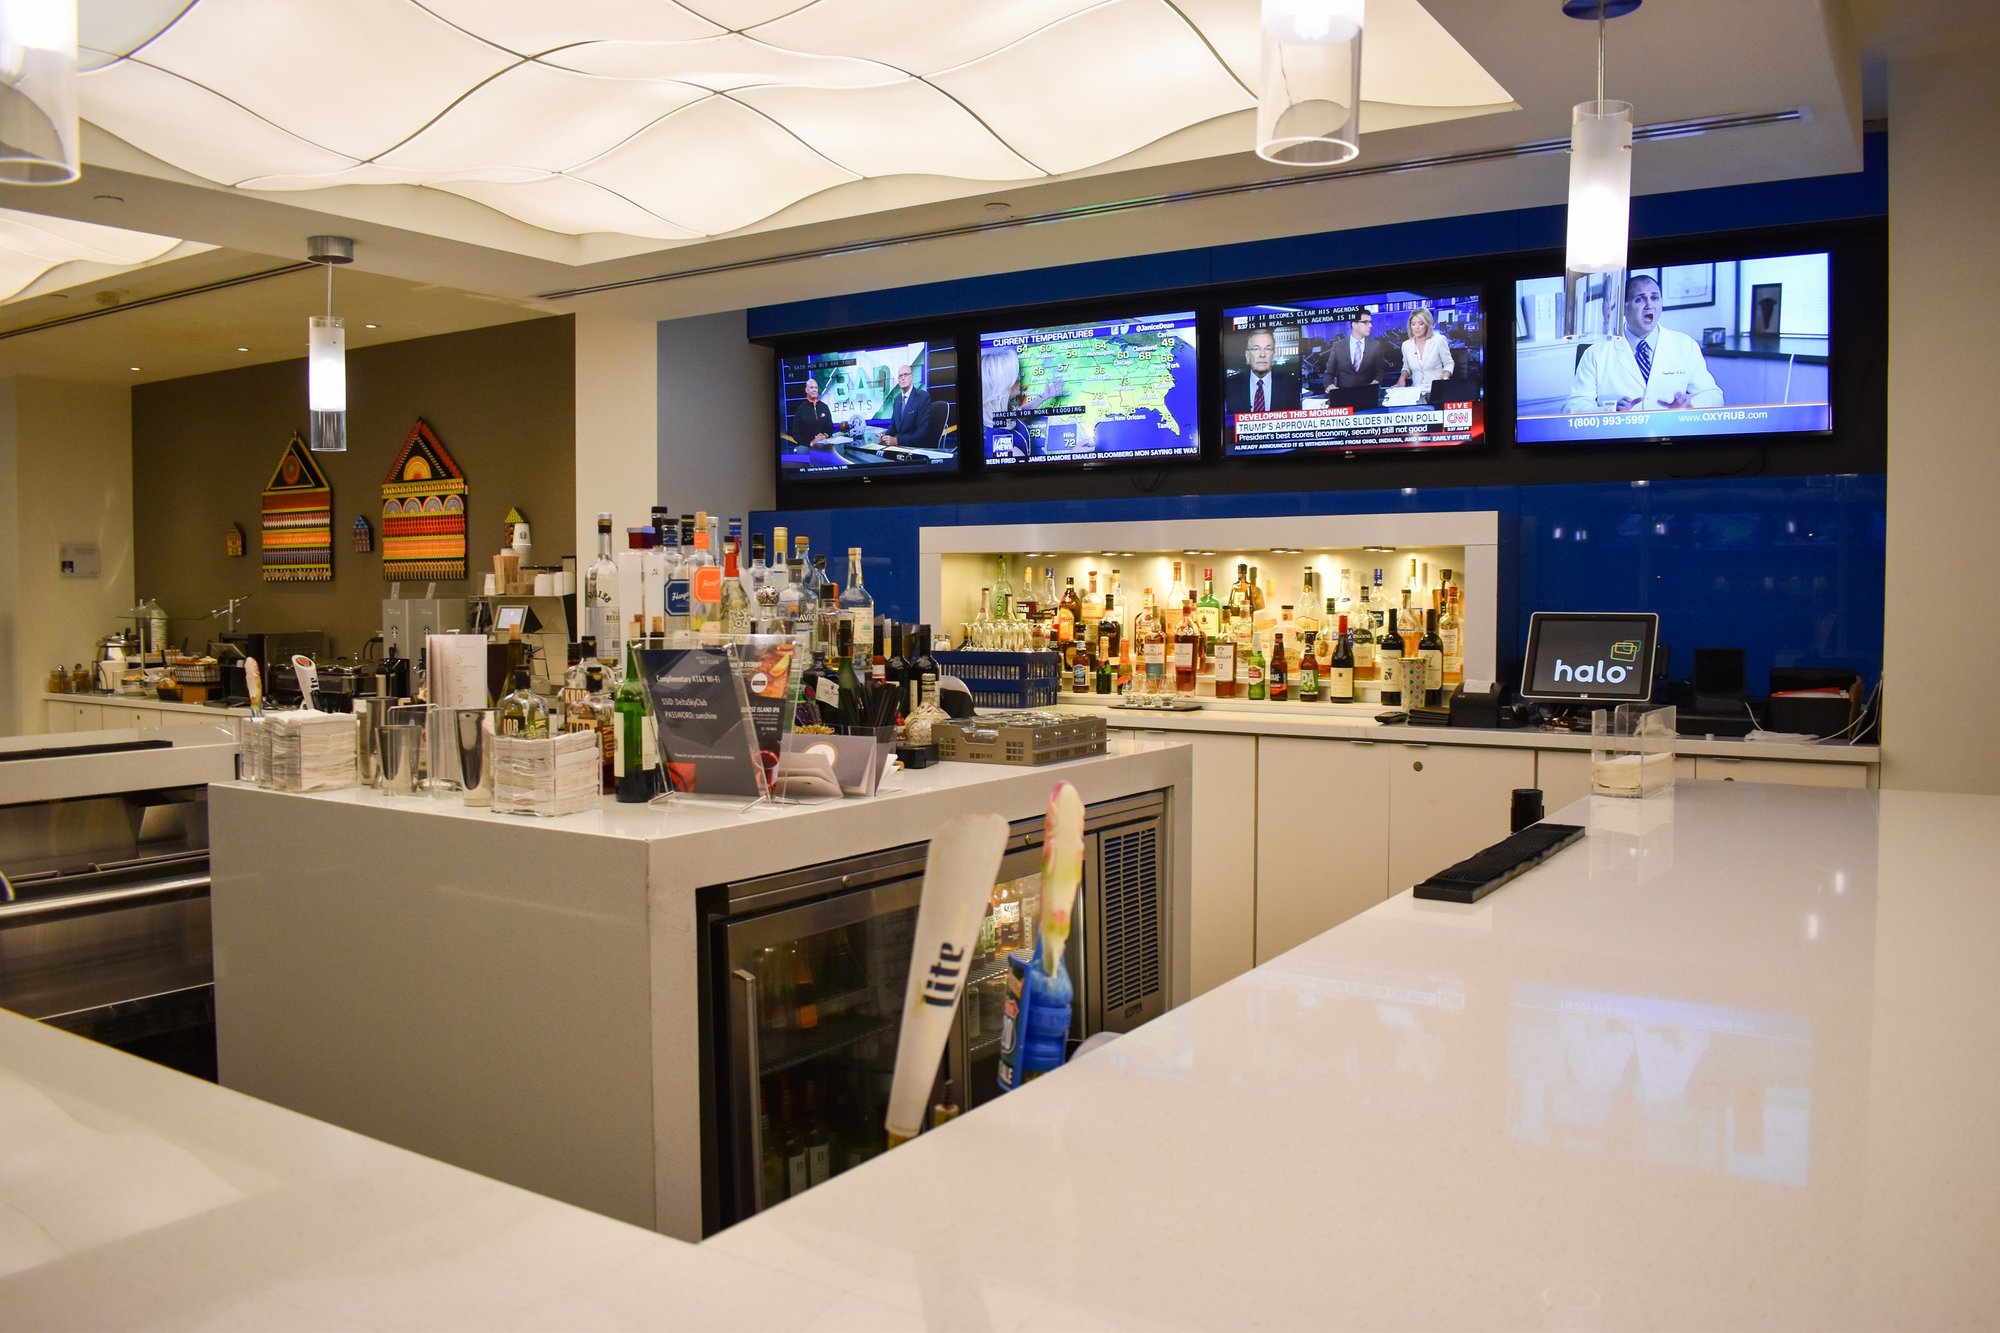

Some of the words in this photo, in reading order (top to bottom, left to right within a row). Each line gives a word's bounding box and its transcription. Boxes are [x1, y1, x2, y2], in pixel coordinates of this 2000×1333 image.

[1136, 323, 1175, 332] @JaniceDean
[993, 336, 1030, 347] CURRENT
[1031, 329, 1094, 343] TEMPERATURES
[1162, 338, 1175, 347] 49
[1017, 344, 1029, 353] 64
[1132, 344, 1158, 352] Cleveland
[1117, 351, 1129, 360] 60
[1138, 352, 1151, 361] 68
[1057, 364, 1069, 372] 57
[835, 365, 892, 402] BAD
[834, 400, 873, 412] BEATS
[1020, 409, 1031, 417] FOR
[1238, 411, 1288, 421] DEVELOPING
[1289, 410, 1308, 418] THIS
[1309, 408, 1349, 417] MORNING
[1678, 411, 1768, 422] www.OXYRUB.com
[1238, 422, 1273, 432] TRUMP'S
[1275, 420, 1317, 430] APPROVAL
[1319, 418, 1350, 428] RATING
[1352, 416, 1381, 426] SLIDES
[1384, 415, 1392, 424] IN
[1395, 414, 1413, 423] CNN
[1416, 413, 1437, 423] POLL
[1446, 413, 1468, 423] CNN
[1568, 416, 1600, 429] 1(800)
[1602, 414, 1651, 426] 993-5997
[1238, 432, 1275, 442] President's
[1275, 431, 1290, 439] best
[1351, 427, 1381, 436] security)
[1381, 426, 1394, 434] still
[1408, 425, 1428, 433] good
[1064, 438, 1076, 447] 72
[1047, 454, 1072, 462] DAMORE
[1072, 453, 1097, 461] EMAILED
[1097, 451, 1134, 459] BLOOMBERG
[1150, 448, 1173, 456] SAYING
[1554, 659, 1627, 684] halo
[656, 675, 691, 684] Complimentary
[691, 675, 706, 683] AT&T
[706, 675, 721, 683] Wi-Fi
[674, 698, 708, 707] DeltaSkyClub
[664, 711, 694, 719] PASSWORD:
[695, 712, 718, 720] sunshine
